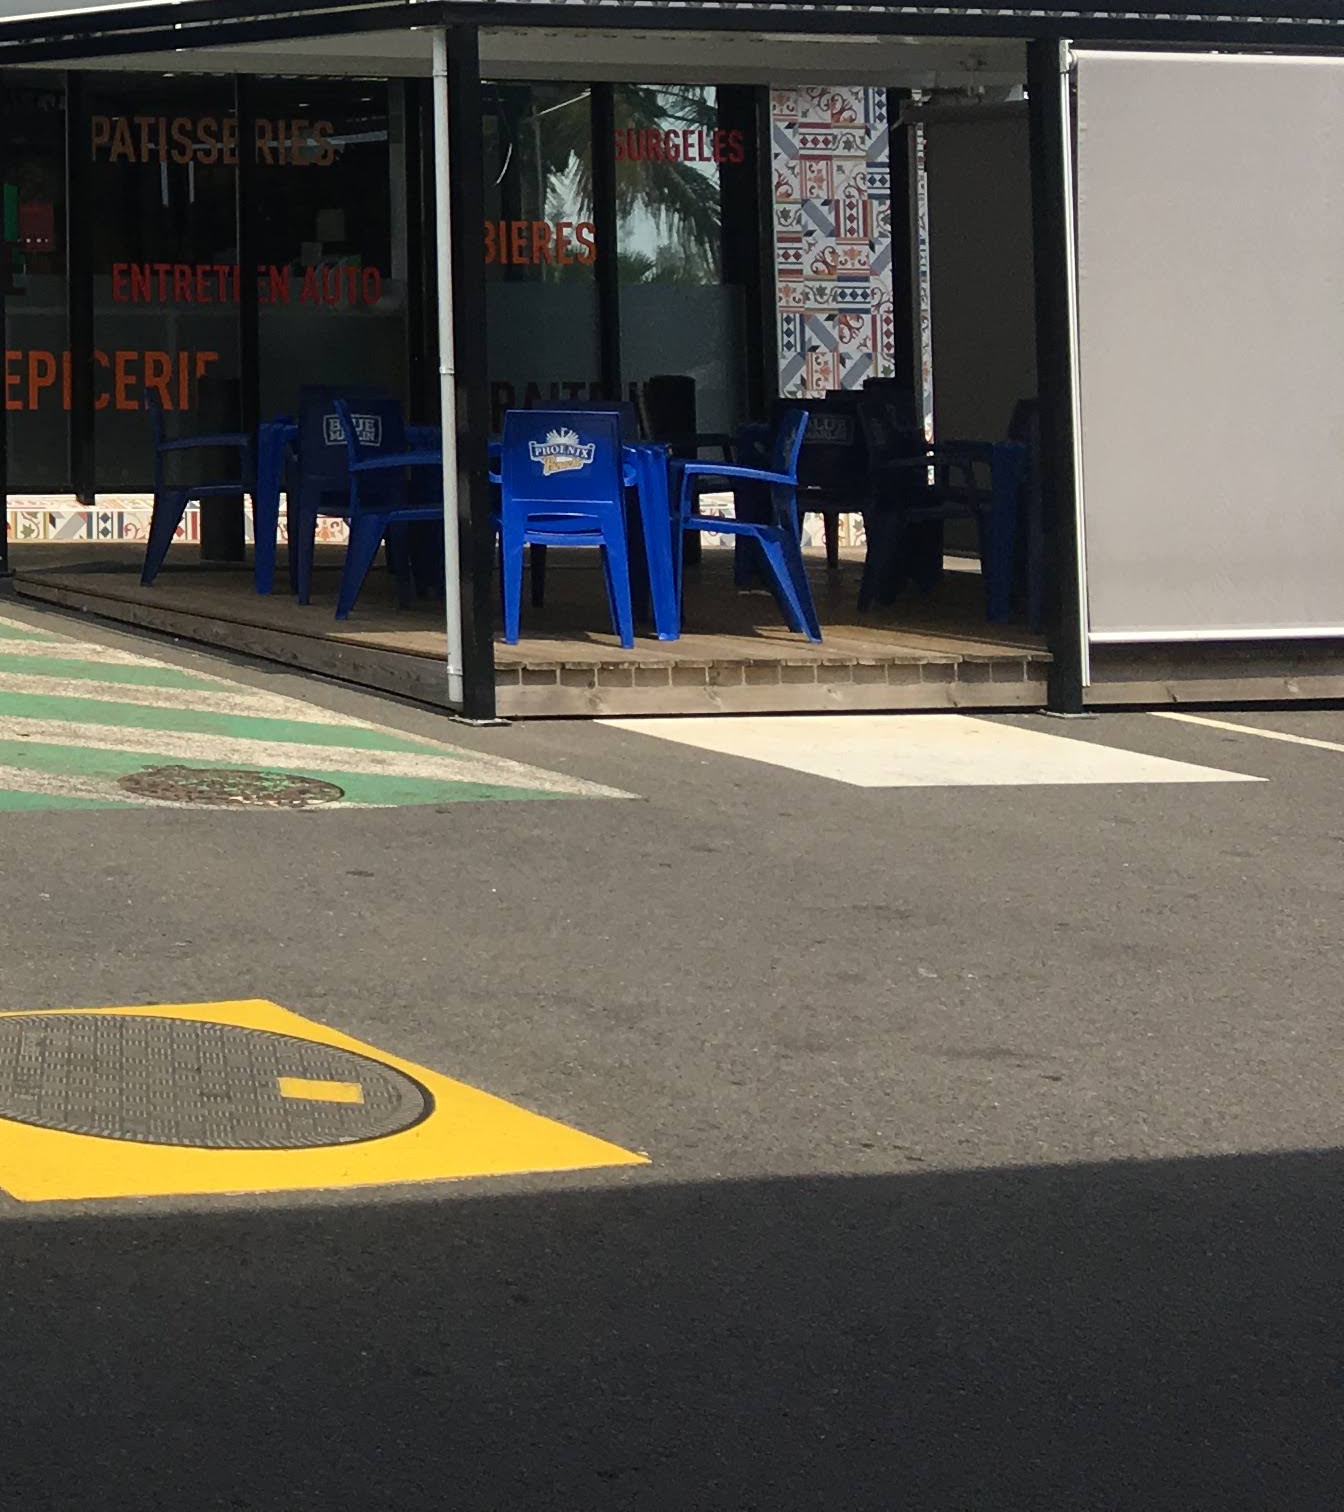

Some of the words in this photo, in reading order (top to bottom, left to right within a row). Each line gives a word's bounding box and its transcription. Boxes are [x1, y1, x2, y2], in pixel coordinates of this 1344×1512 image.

[91, 115, 335, 166] PATISSERIES
[613, 128, 745, 163] SURGELES
[483, 220, 596, 265] BIERES
[300, 264, 381, 306] AUTO
[329, 419, 376, 432] BUE
